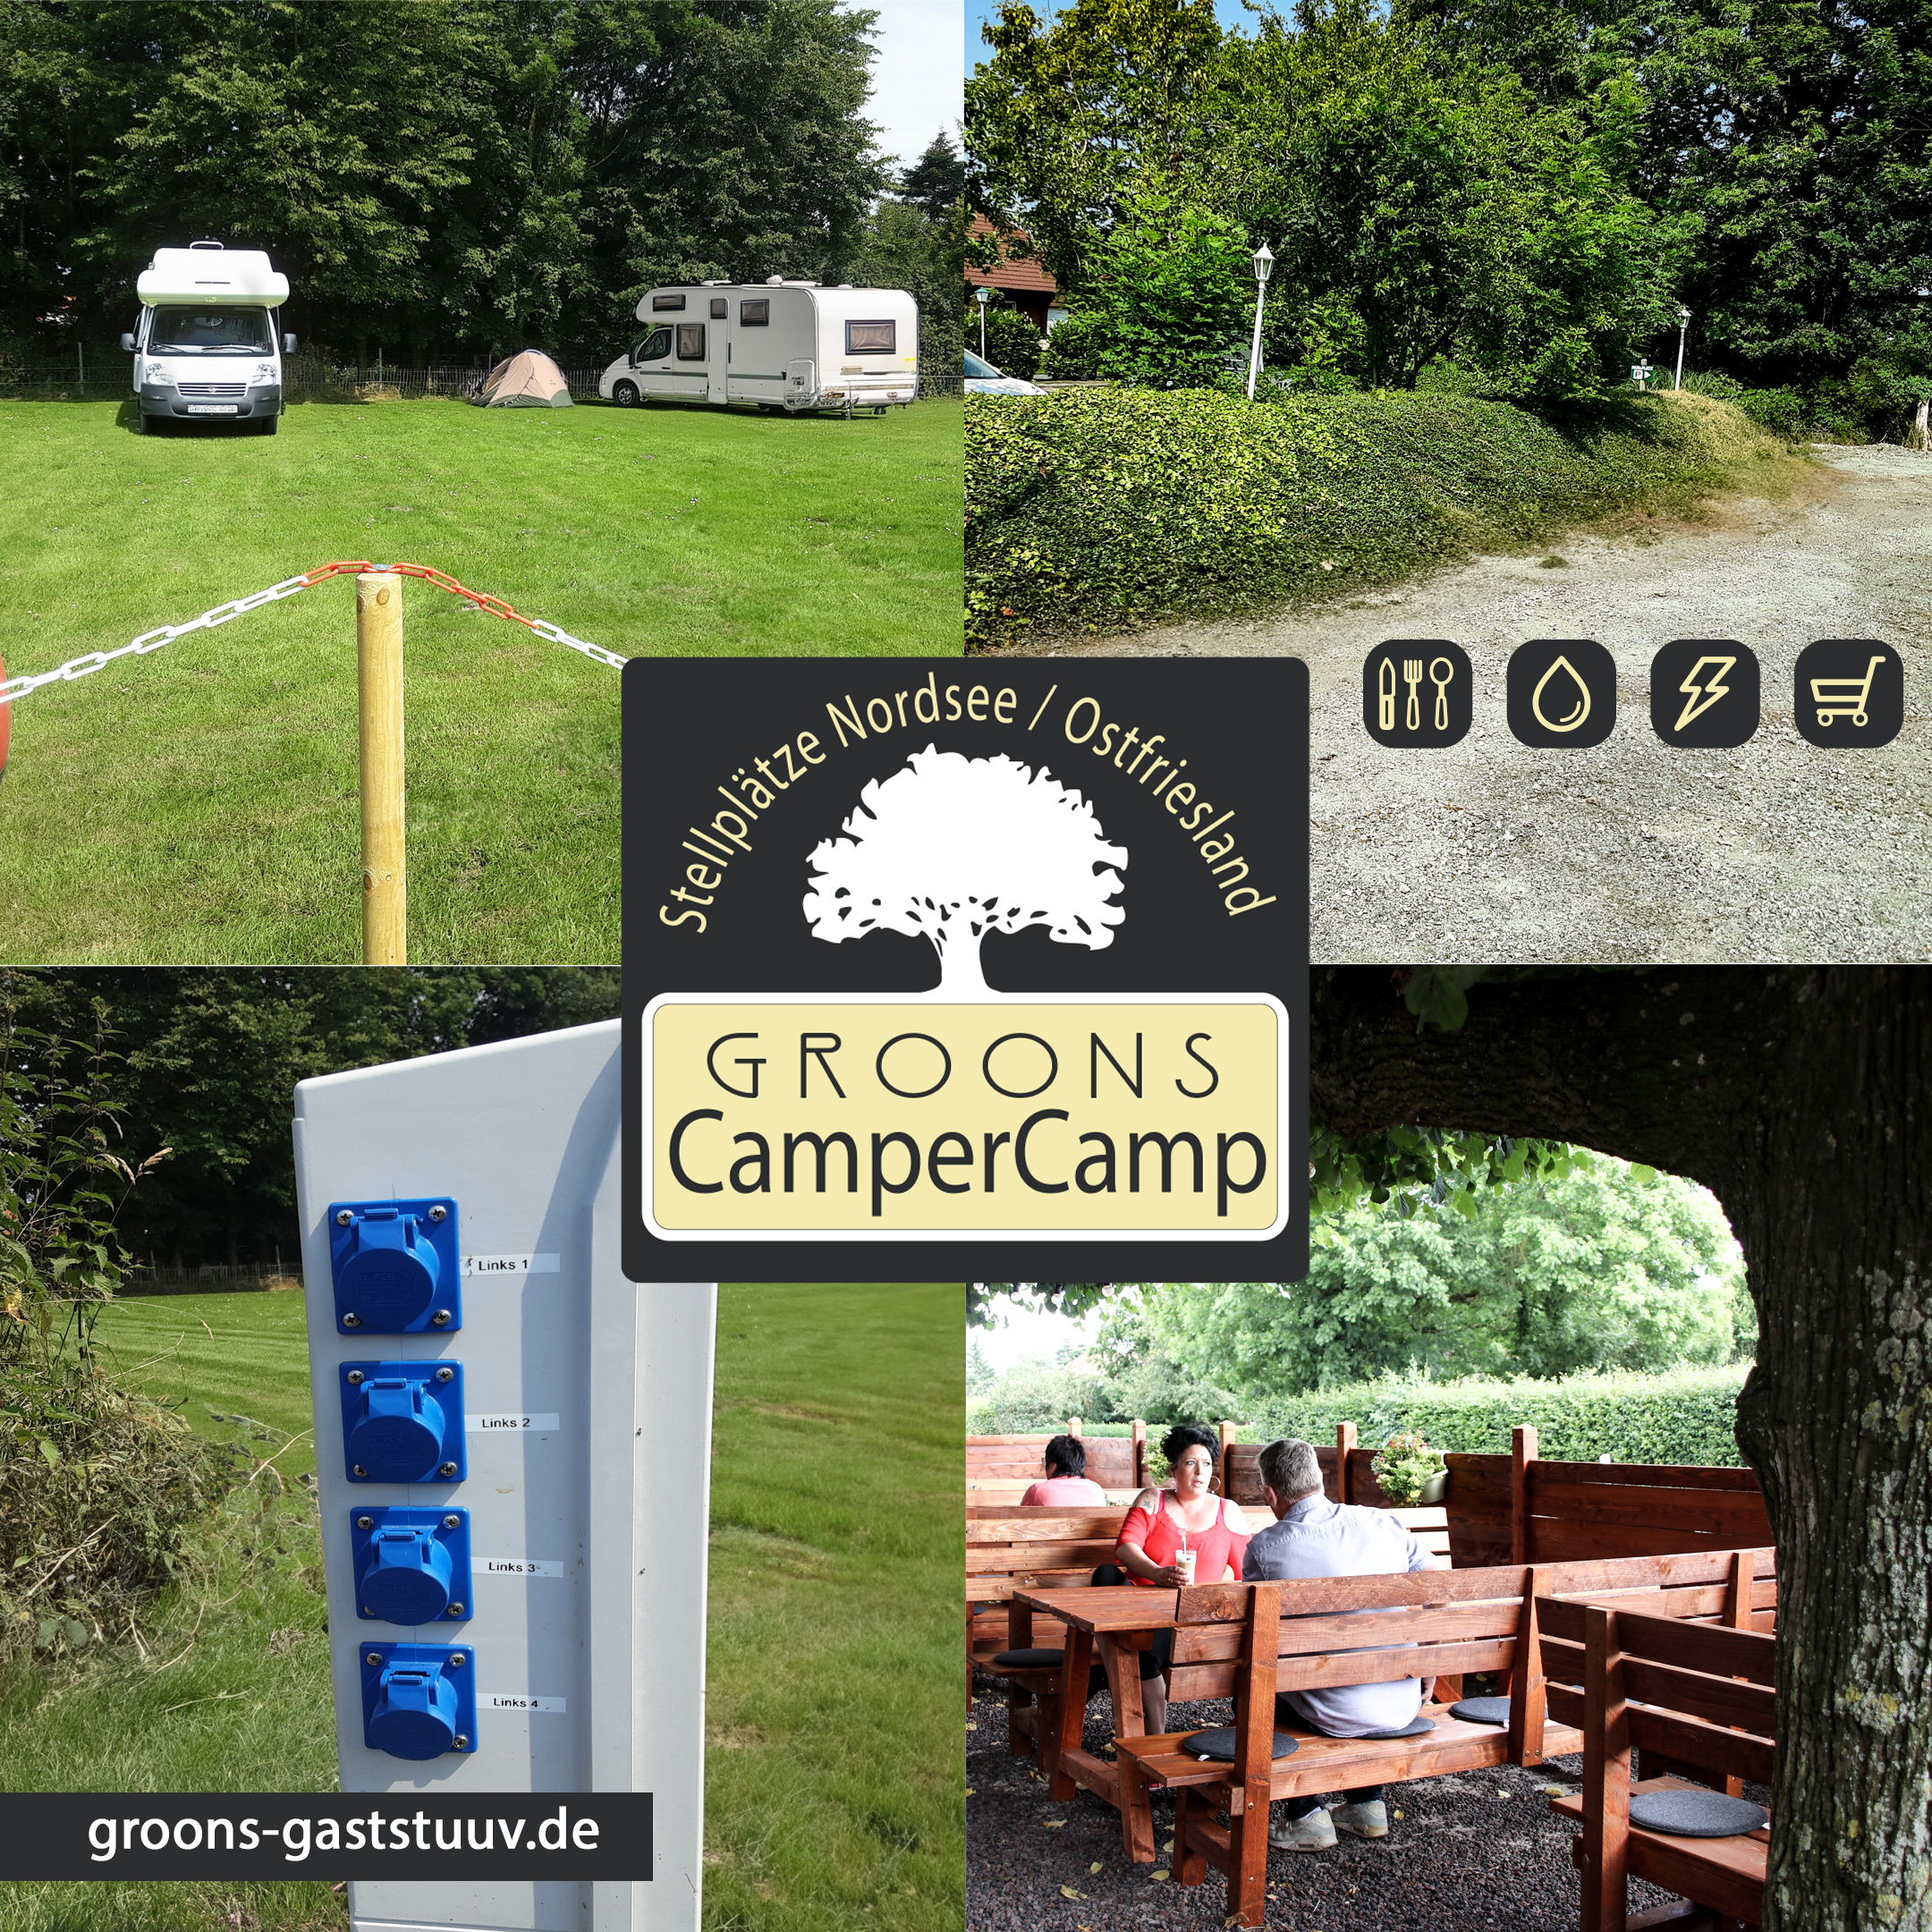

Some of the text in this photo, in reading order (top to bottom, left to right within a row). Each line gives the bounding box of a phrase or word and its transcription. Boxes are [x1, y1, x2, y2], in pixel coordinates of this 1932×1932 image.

[479, 1259, 529, 1271] Links 1
[481, 1418, 530, 1428] Links 2
[488, 1562, 536, 1572] Links 3
[494, 1698, 538, 1708] Links 4
